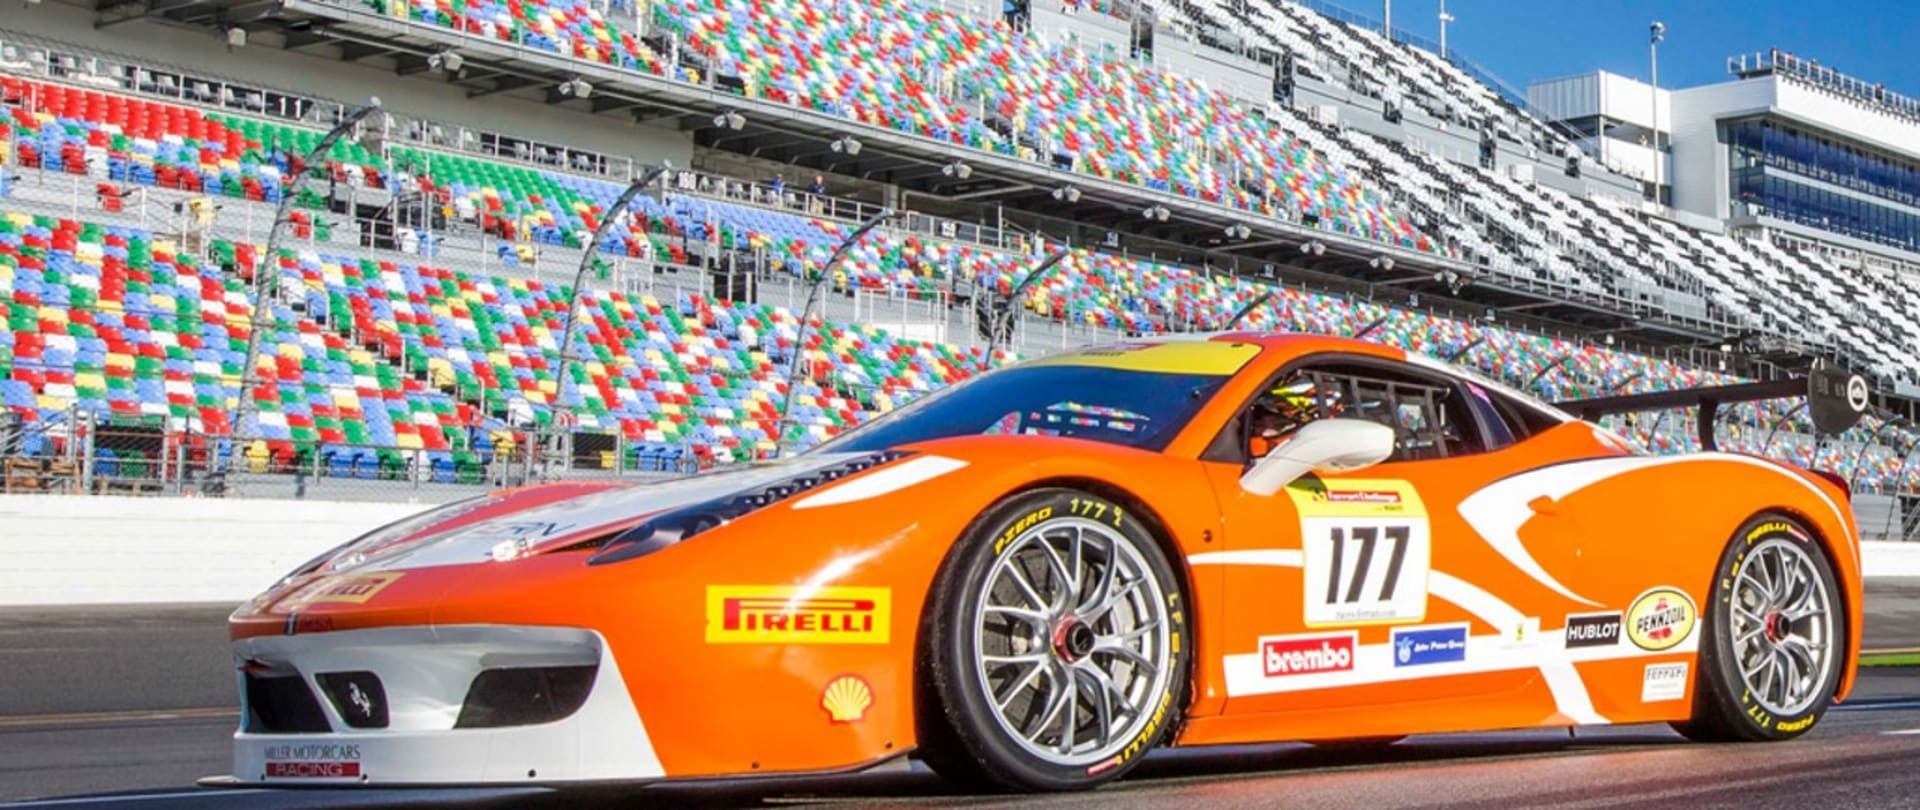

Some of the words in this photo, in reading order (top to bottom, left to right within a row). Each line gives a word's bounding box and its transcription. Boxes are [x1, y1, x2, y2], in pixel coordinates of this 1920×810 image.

[1070, 498, 1107, 518] 177
[1326, 526, 1410, 605] 177
[723, 597, 875, 632] PIRELLI
[1636, 605, 1686, 635] PENNZOIL
[1568, 622, 1620, 641] HUBLOT
[1266, 642, 1350, 673] brembo
[293, 744, 360, 760] MOTORCARS
[275, 763, 344, 777] RACING
